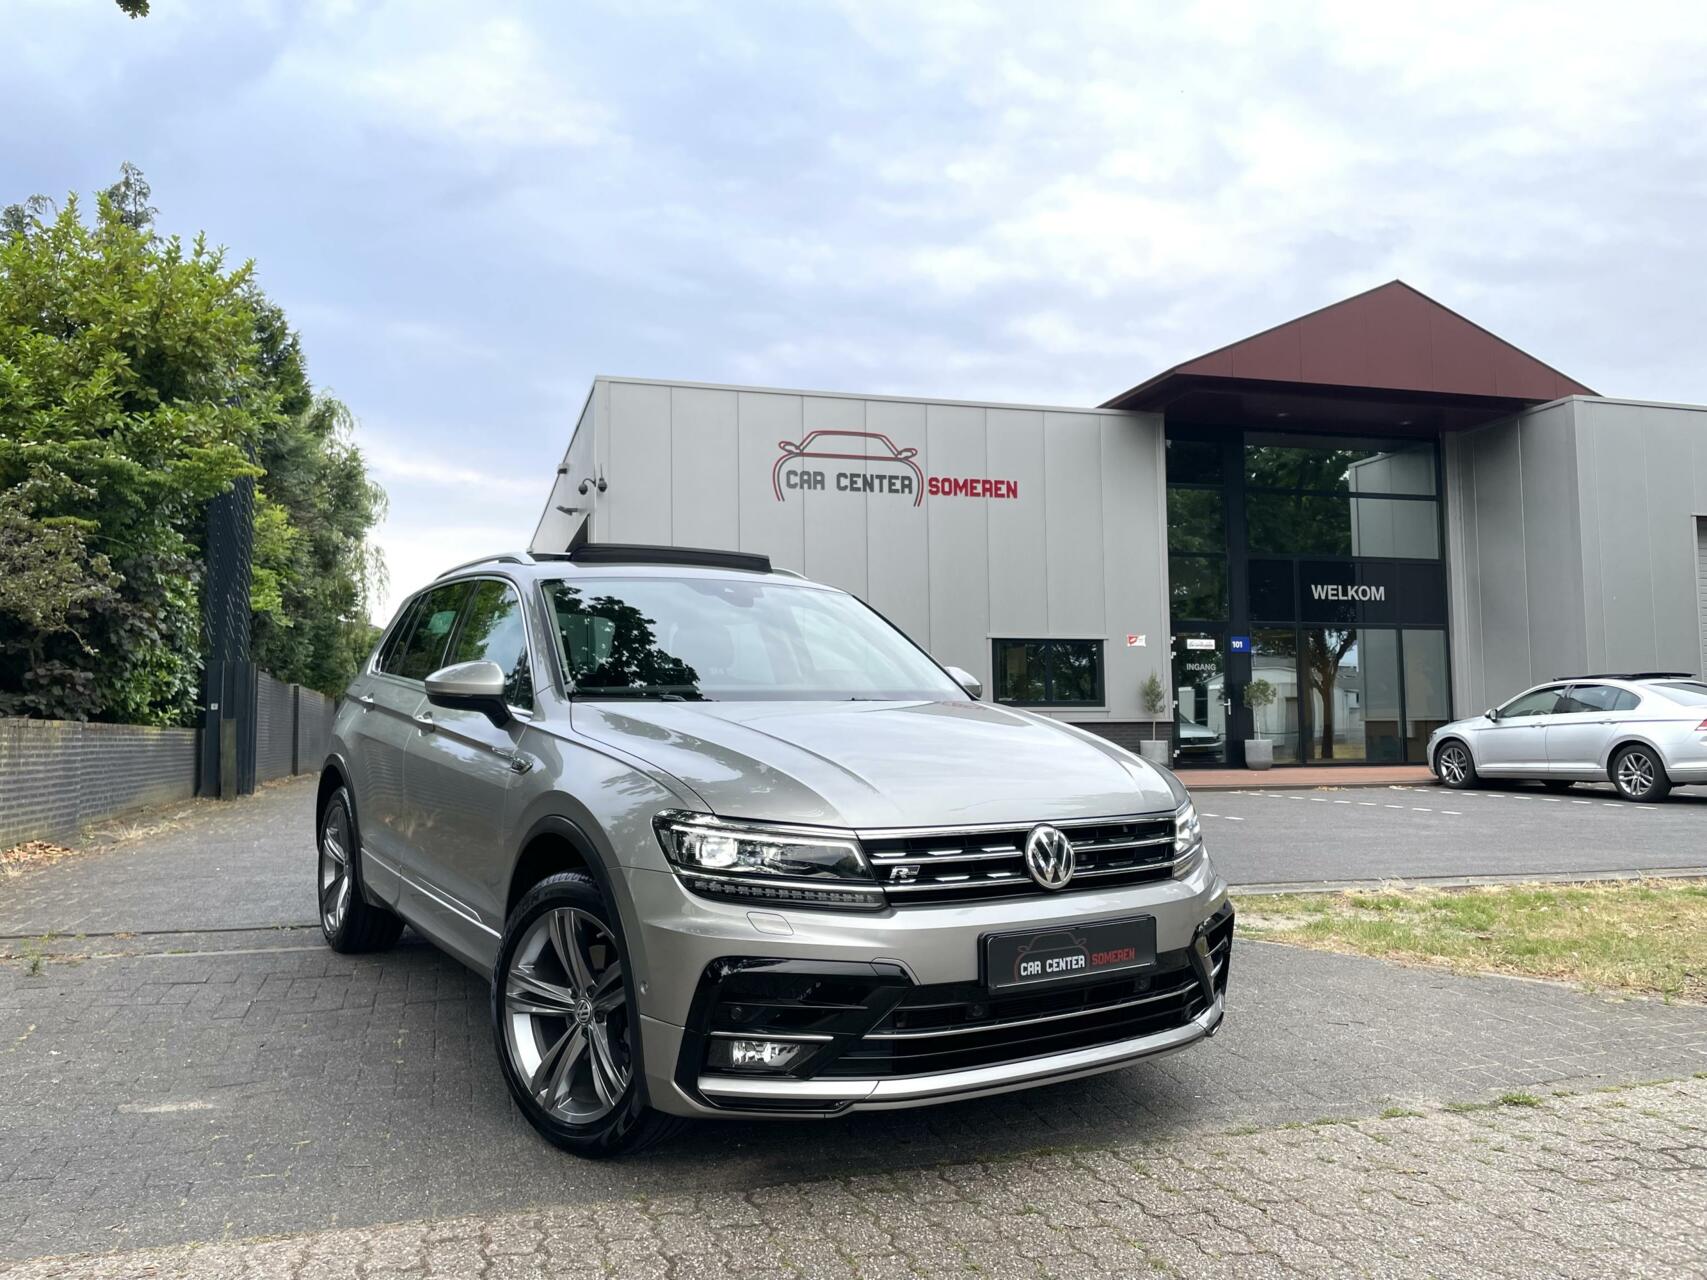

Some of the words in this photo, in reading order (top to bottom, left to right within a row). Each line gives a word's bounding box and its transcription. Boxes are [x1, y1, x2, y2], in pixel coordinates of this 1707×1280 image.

[786, 470, 825, 490] CAR
[836, 472, 913, 494] CENTER
[928, 477, 1018, 499] SOMEREN
[1311, 584, 1385, 601] WELKOM
[1231, 640, 1243, 649] 101
[1186, 663, 1217, 671] INGANG
[1020, 961, 1042, 976] CAR
[1046, 955, 1086, 973] CENTER
[1091, 948, 1136, 966] SOMEREN
